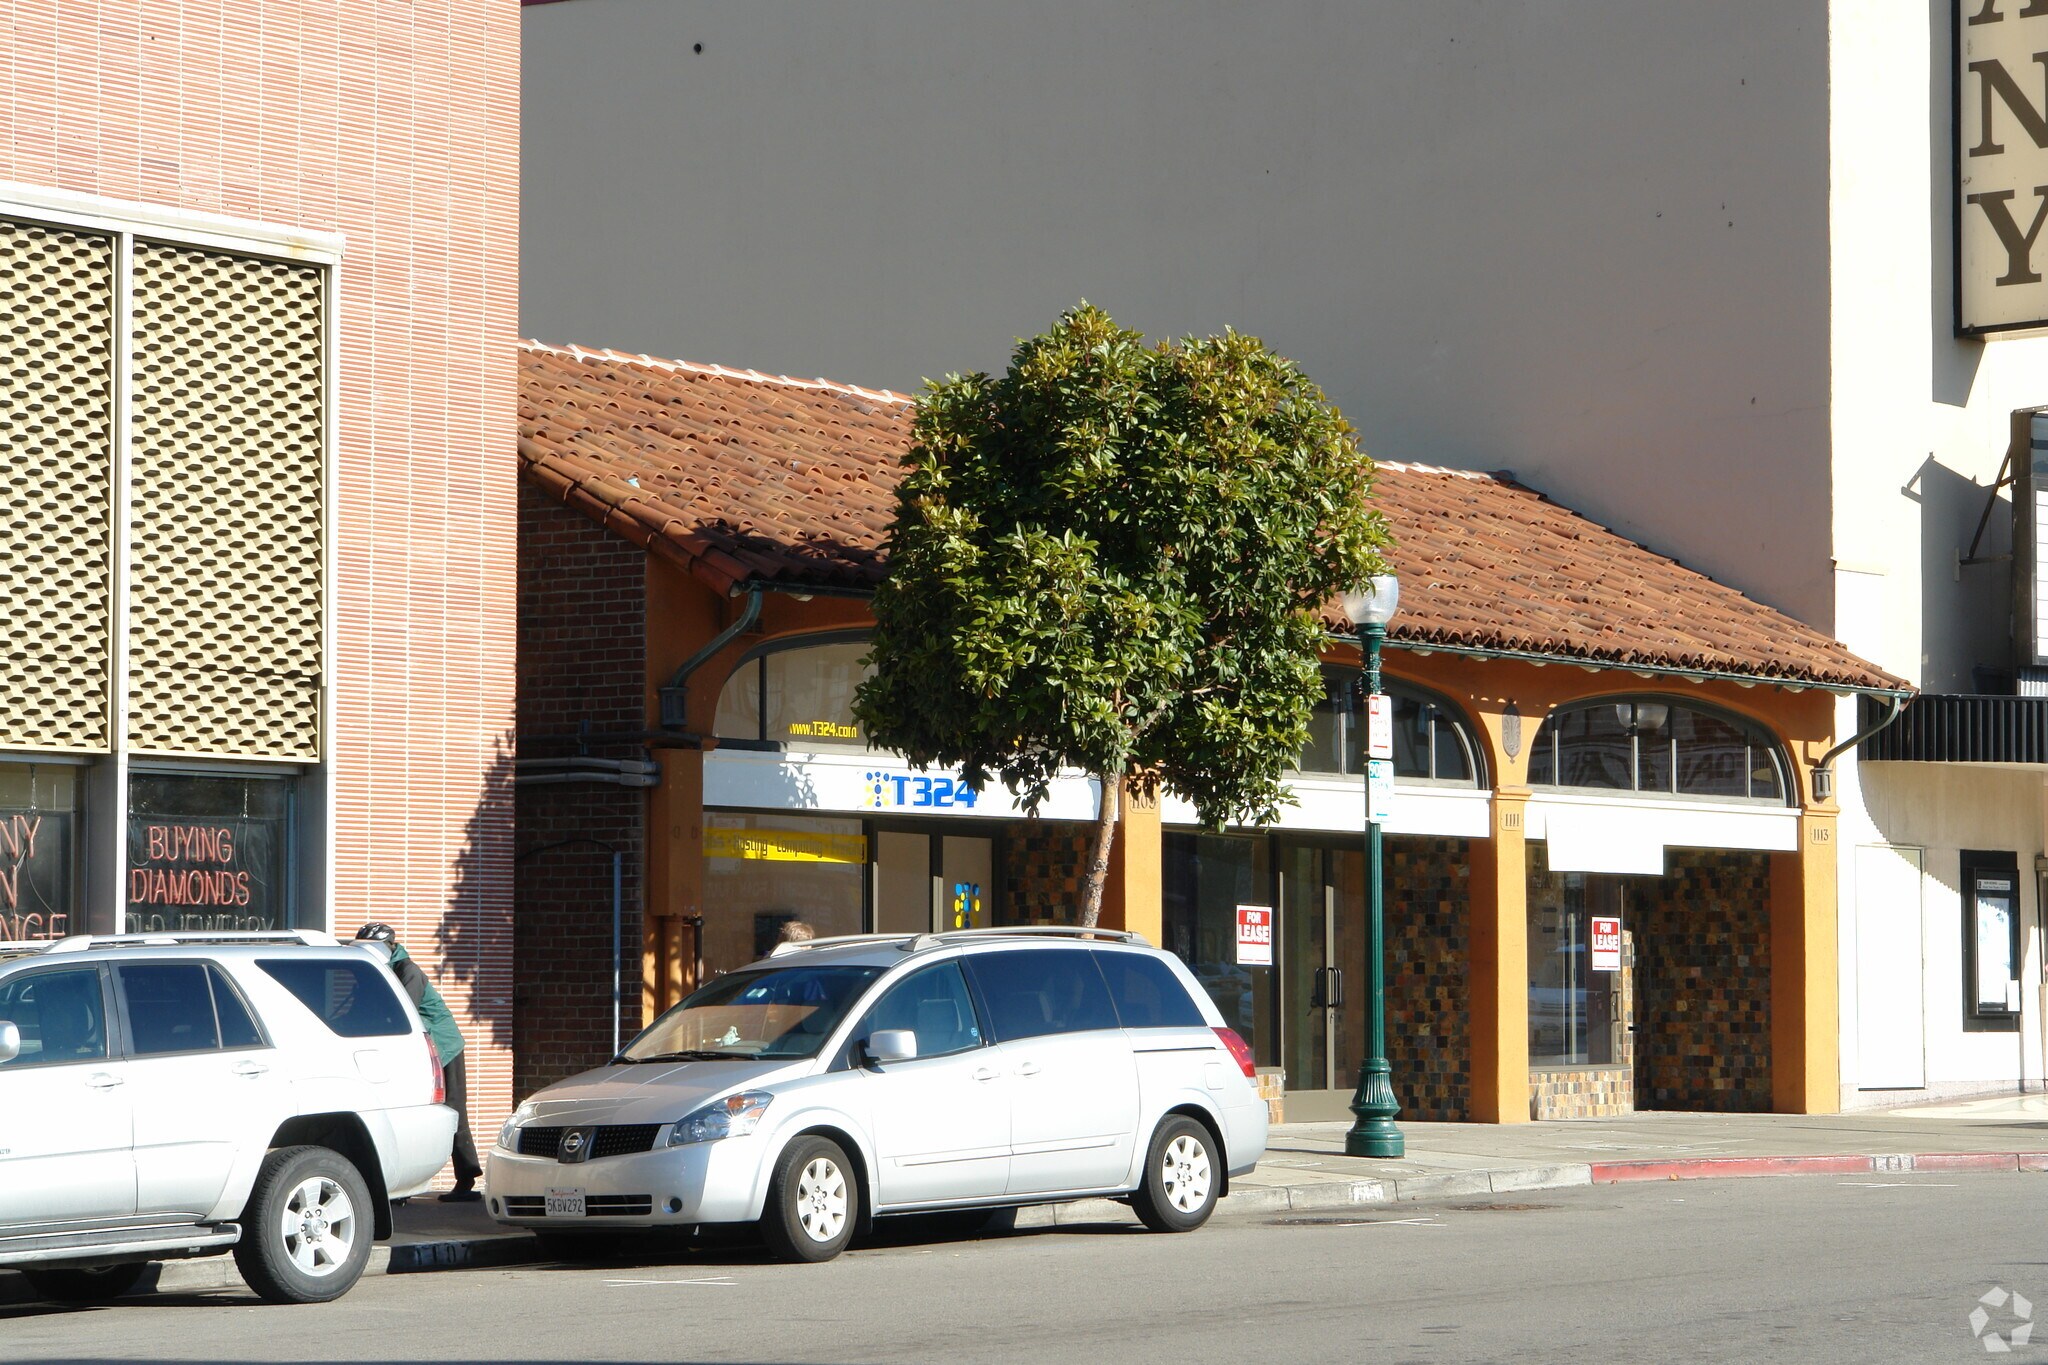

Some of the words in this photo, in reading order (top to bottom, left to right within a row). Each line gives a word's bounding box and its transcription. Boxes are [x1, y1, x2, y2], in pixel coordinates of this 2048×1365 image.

[1967, 0, 2048, 287] NY
[890, 775, 978, 808] T324
[1505, 813, 1520, 827] 1111
[1813, 828, 1829, 841] 1113
[149, 825, 233, 863] BUYING
[131, 868, 250, 906] DIAMONDS
[1246, 911, 1262, 924] FOR
[1239, 923, 1269, 943] LEASE
[1599, 922, 1613, 934] FOR
[1594, 934, 1619, 951] LEASE
[547, 1198, 584, 1213] 5KBV292
